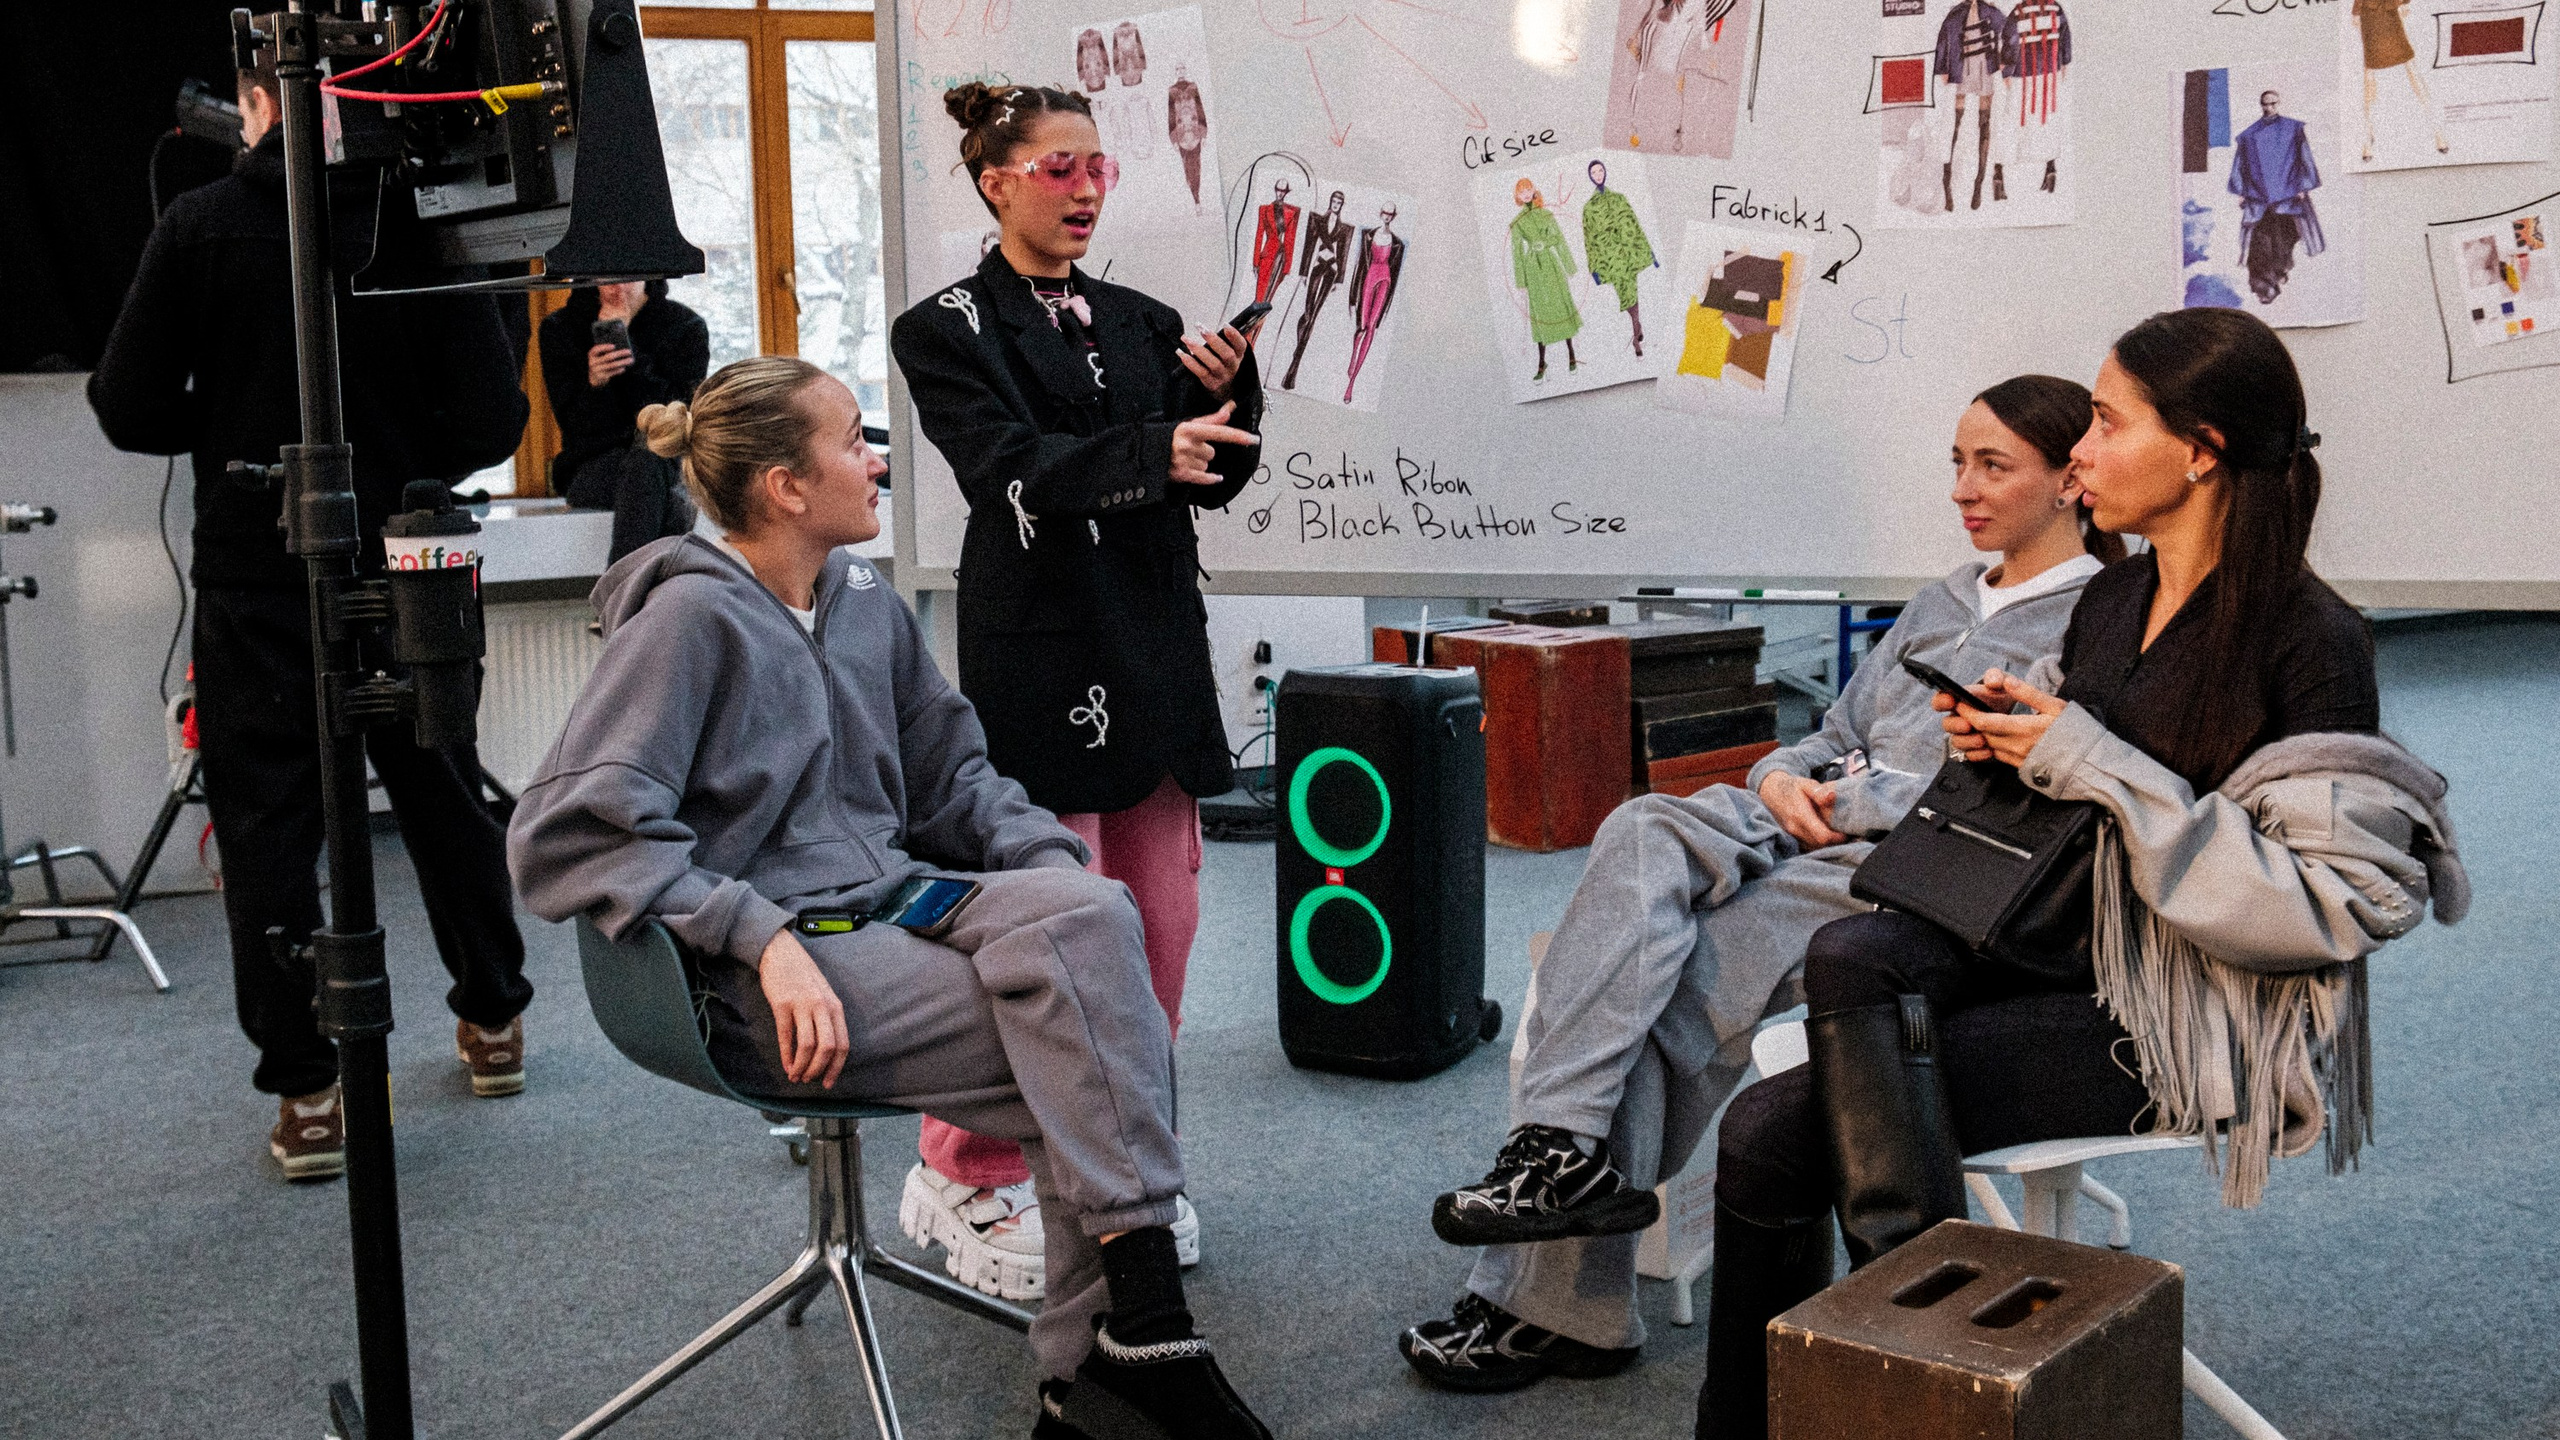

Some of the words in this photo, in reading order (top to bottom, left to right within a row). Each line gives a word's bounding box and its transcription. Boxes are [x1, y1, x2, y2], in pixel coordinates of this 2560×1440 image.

[1503, 129, 1558, 157] size
[1286, 451, 1374, 491] Satin
[1396, 446, 1472, 497] Ribon
[1299, 498, 1400, 544] Black
[1413, 502, 1536, 541] Button
[1551, 501, 1627, 536] Size
